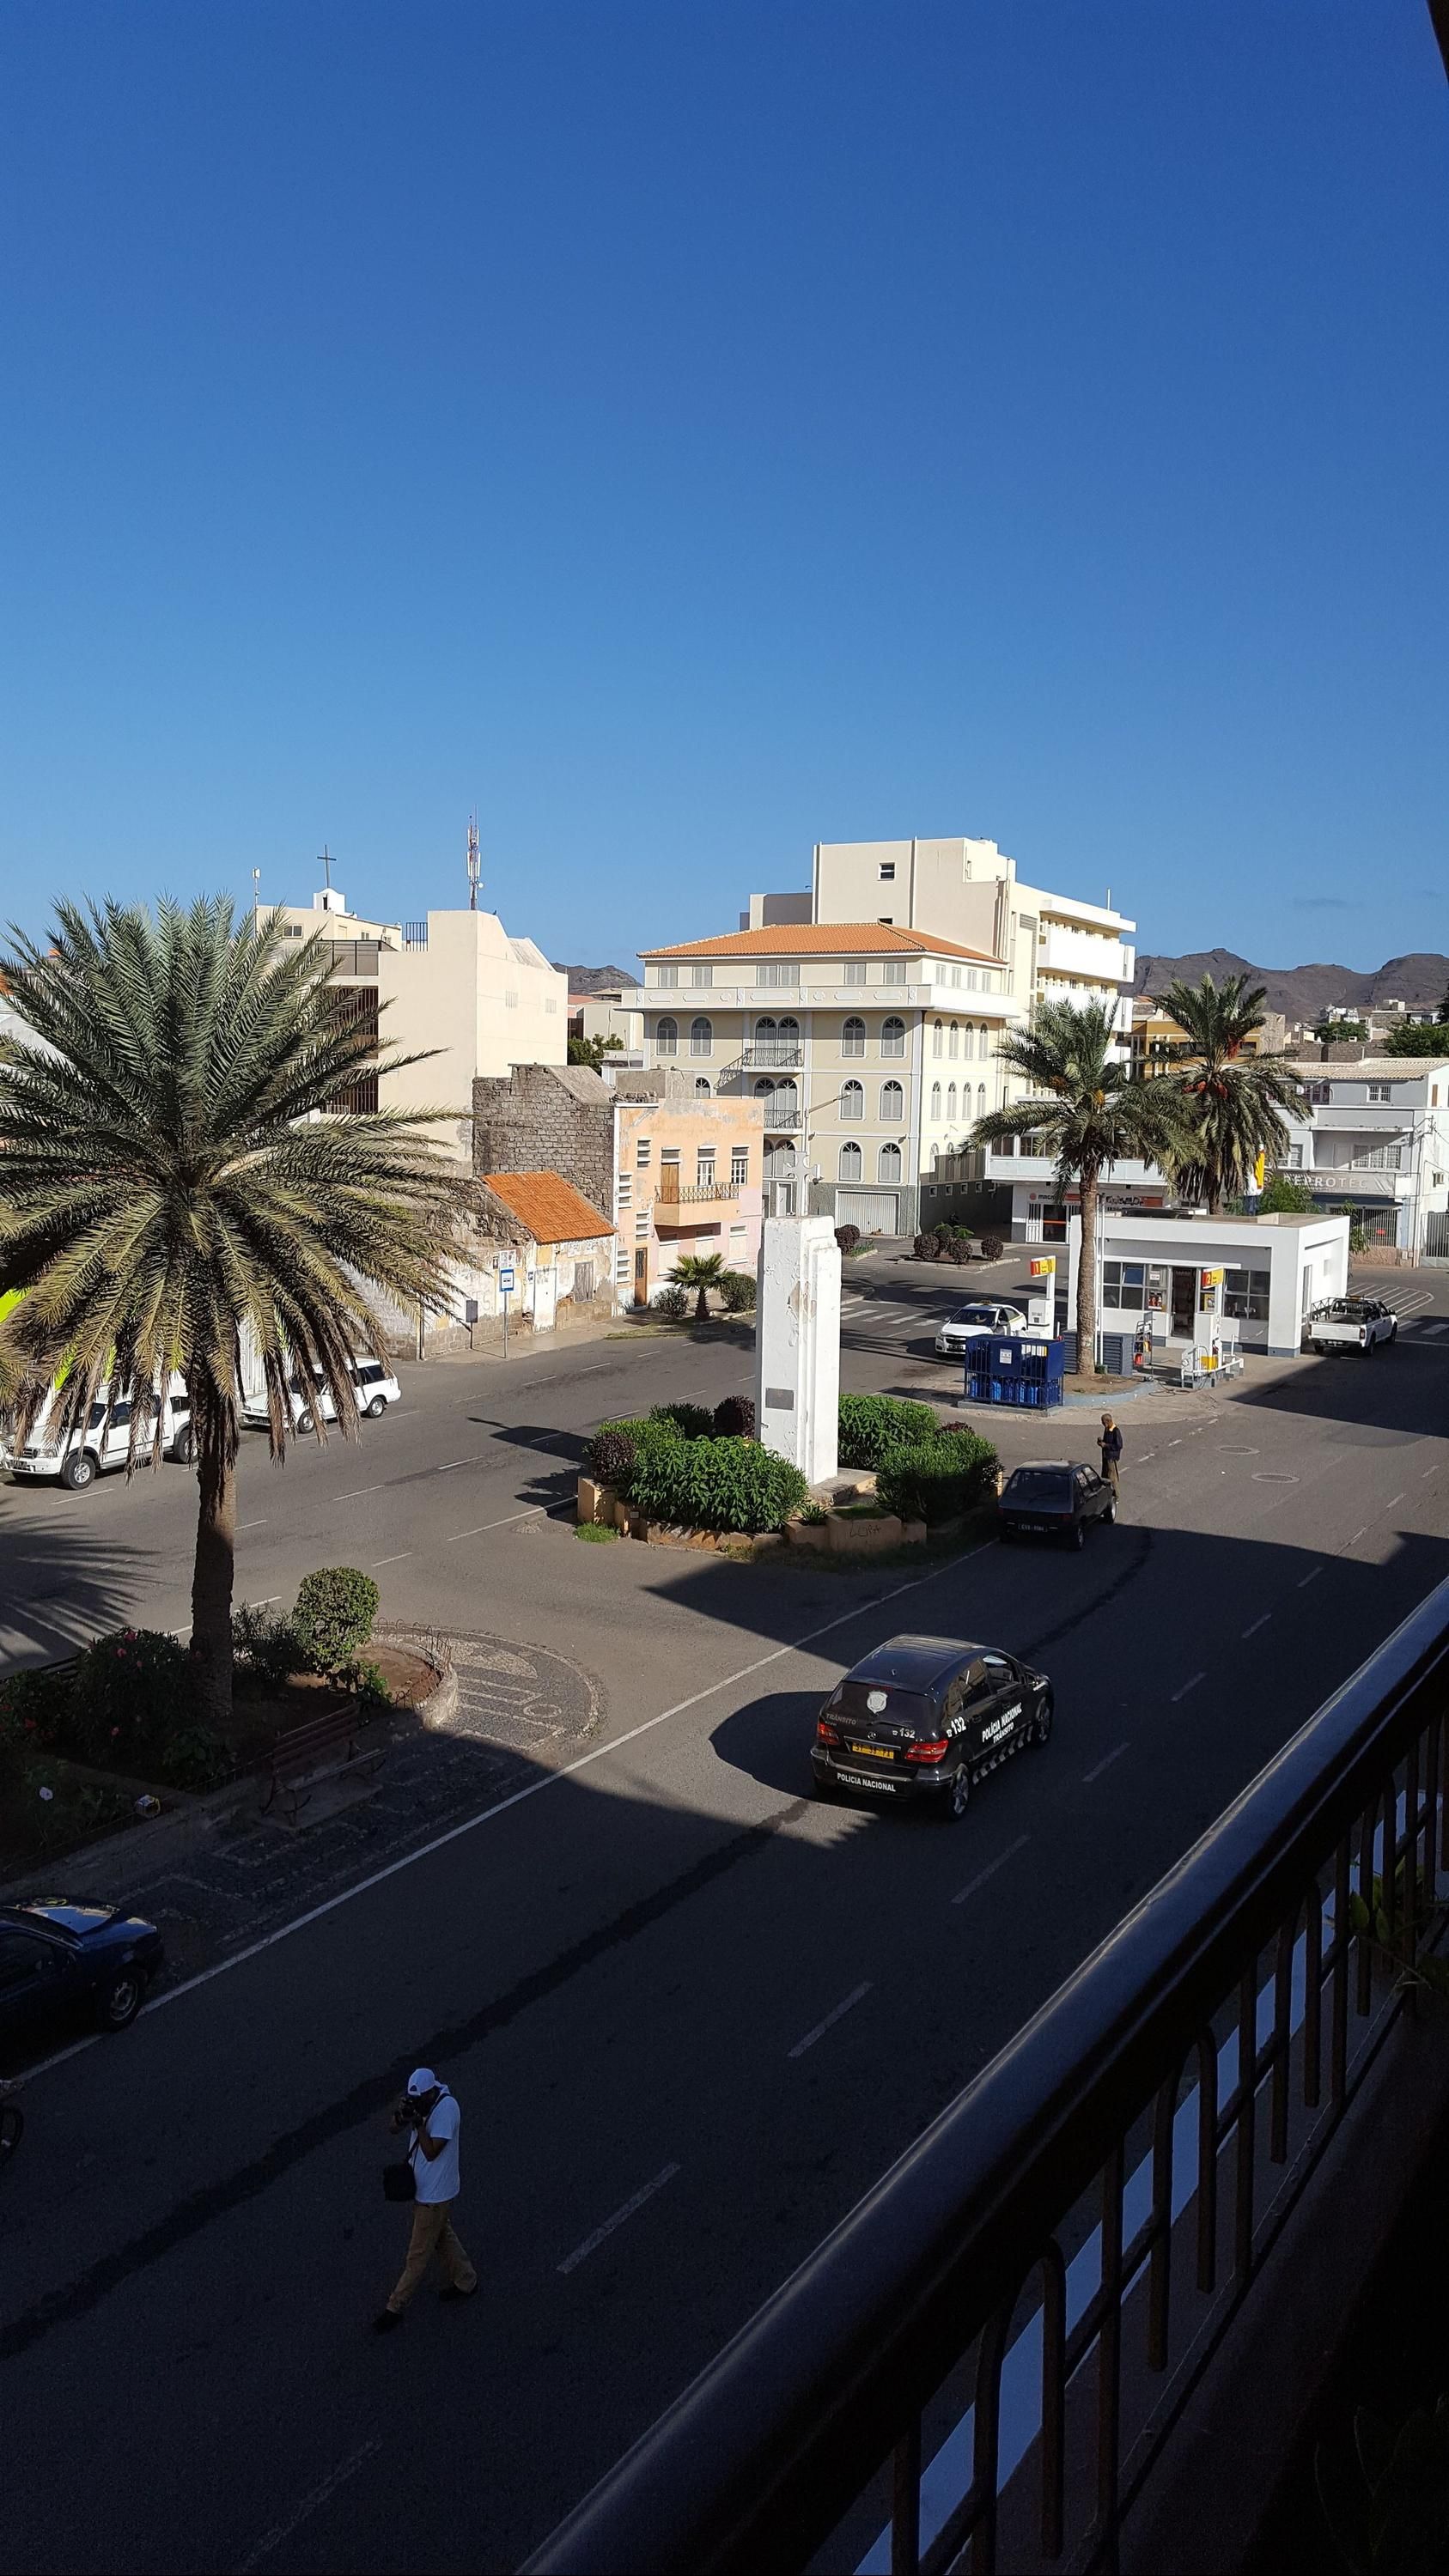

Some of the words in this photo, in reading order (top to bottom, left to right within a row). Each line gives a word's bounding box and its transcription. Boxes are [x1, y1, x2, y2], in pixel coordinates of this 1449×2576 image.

[1001, 1702, 1022, 1728] NACIONAL
[899, 1728, 916, 1739] 132
[951, 1716, 966, 1735] 132
[861, 1779, 897, 1792] NACIONAL
